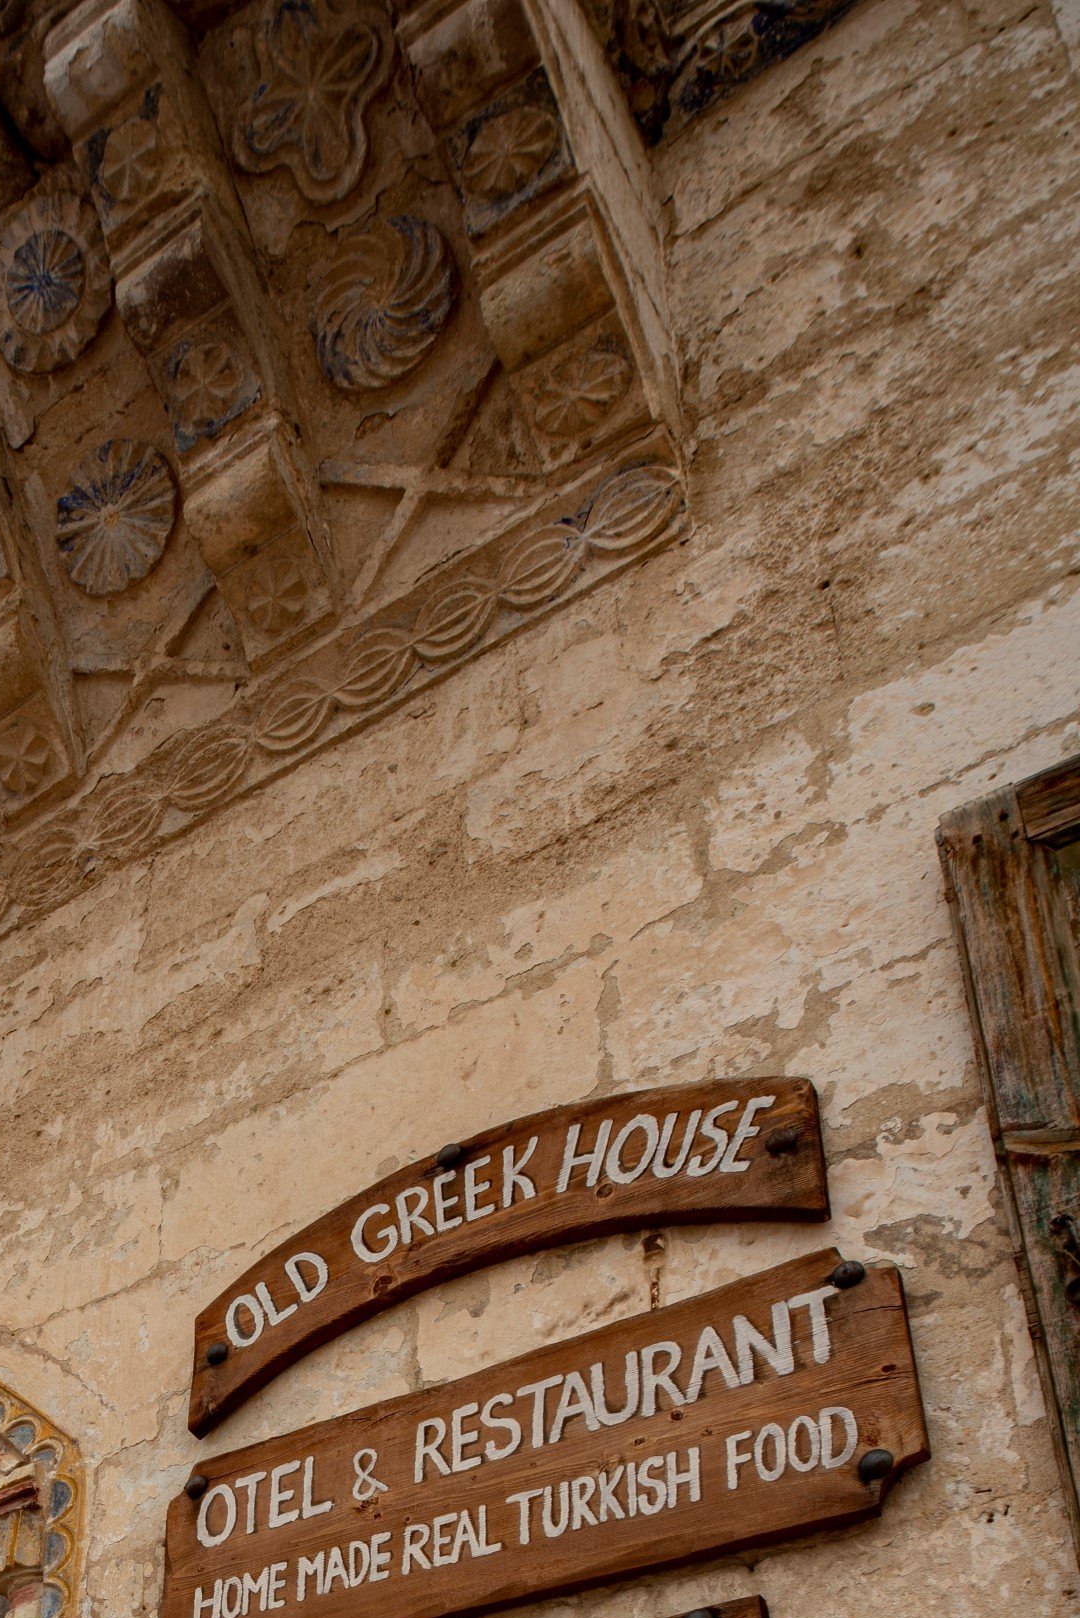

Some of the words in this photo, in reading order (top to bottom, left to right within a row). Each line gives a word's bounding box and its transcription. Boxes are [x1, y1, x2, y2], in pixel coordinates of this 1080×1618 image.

[225, 1251, 330, 1350] OLD
[350, 1137, 539, 1264] GREEK
[556, 1095, 777, 1194] HOUSE
[196, 1453, 334, 1549] OTEL
[352, 1448, 389, 1500] &
[414, 1285, 840, 1484] RESTAURANT
[297, 1532, 392, 1601] MADE
[401, 1504, 503, 1575] REAL
[506, 1446, 702, 1545] TURKISH
[725, 1406, 859, 1490] FOOD
